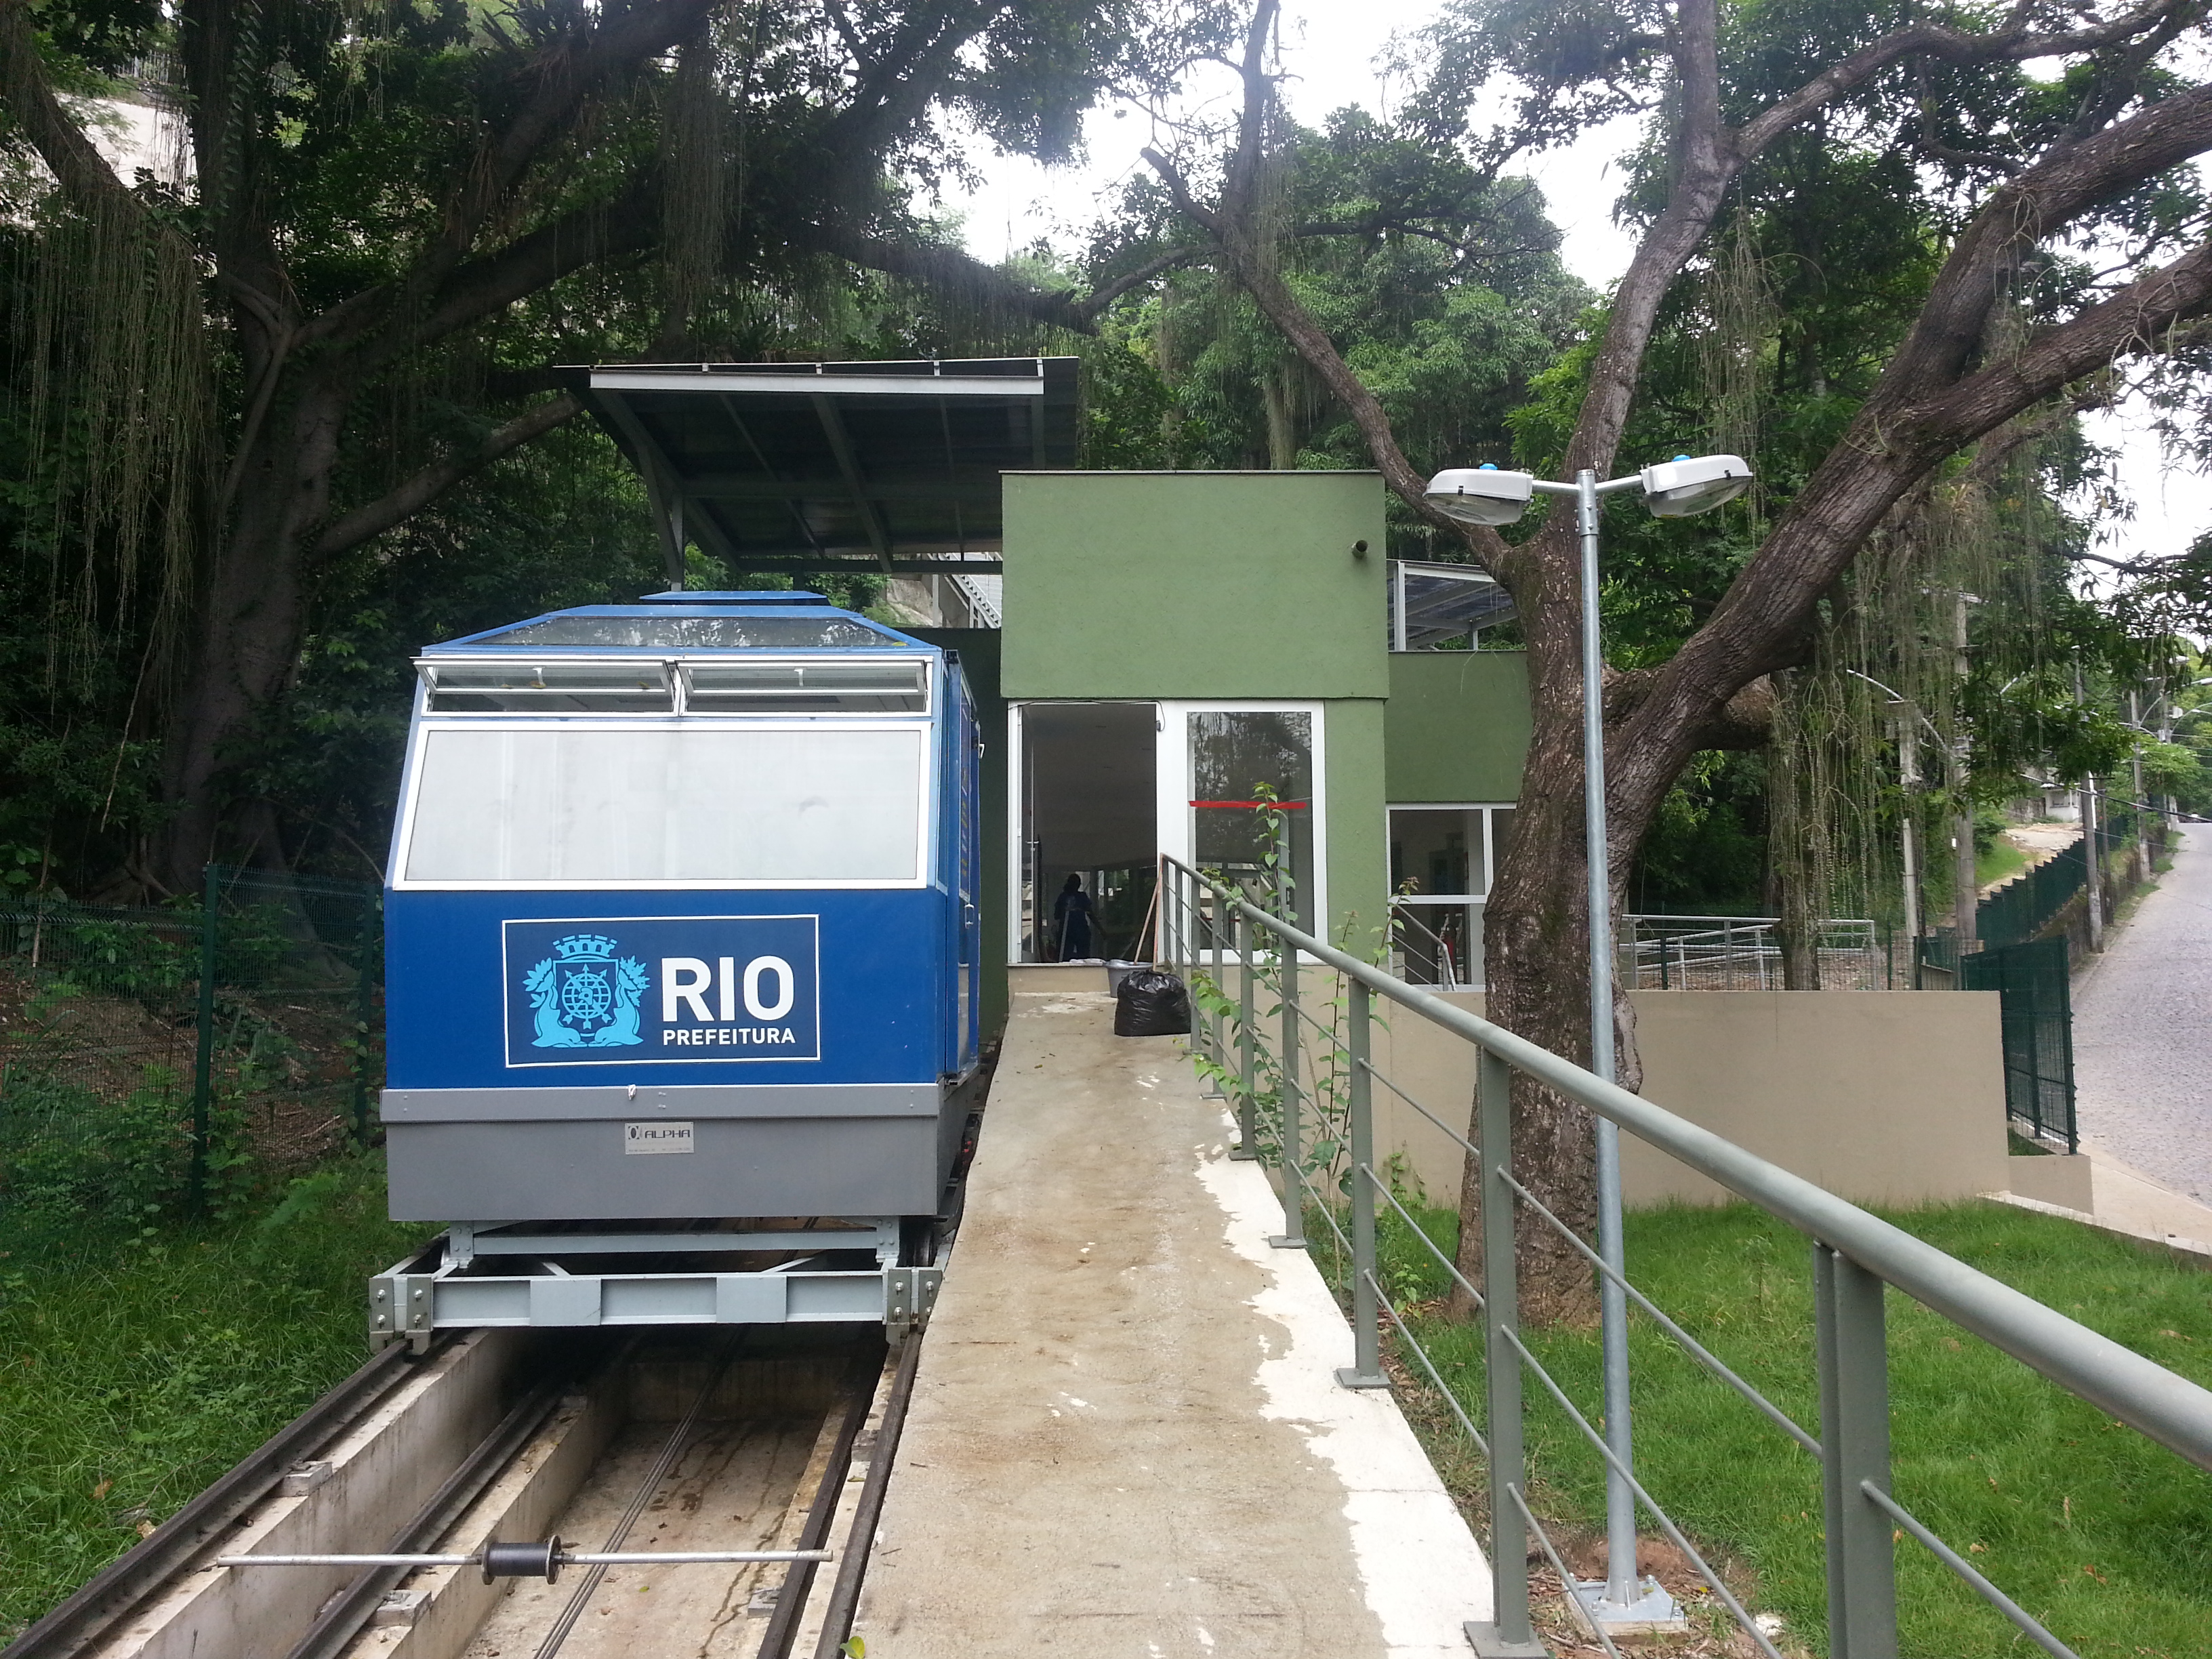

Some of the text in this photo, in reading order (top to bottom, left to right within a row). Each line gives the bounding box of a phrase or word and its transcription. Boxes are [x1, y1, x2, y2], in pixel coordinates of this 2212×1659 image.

[661, 956, 794, 1022] RIO
[663, 1027, 796, 1046] PREFEITURA
[644, 1129, 691, 1139] ALPHA
